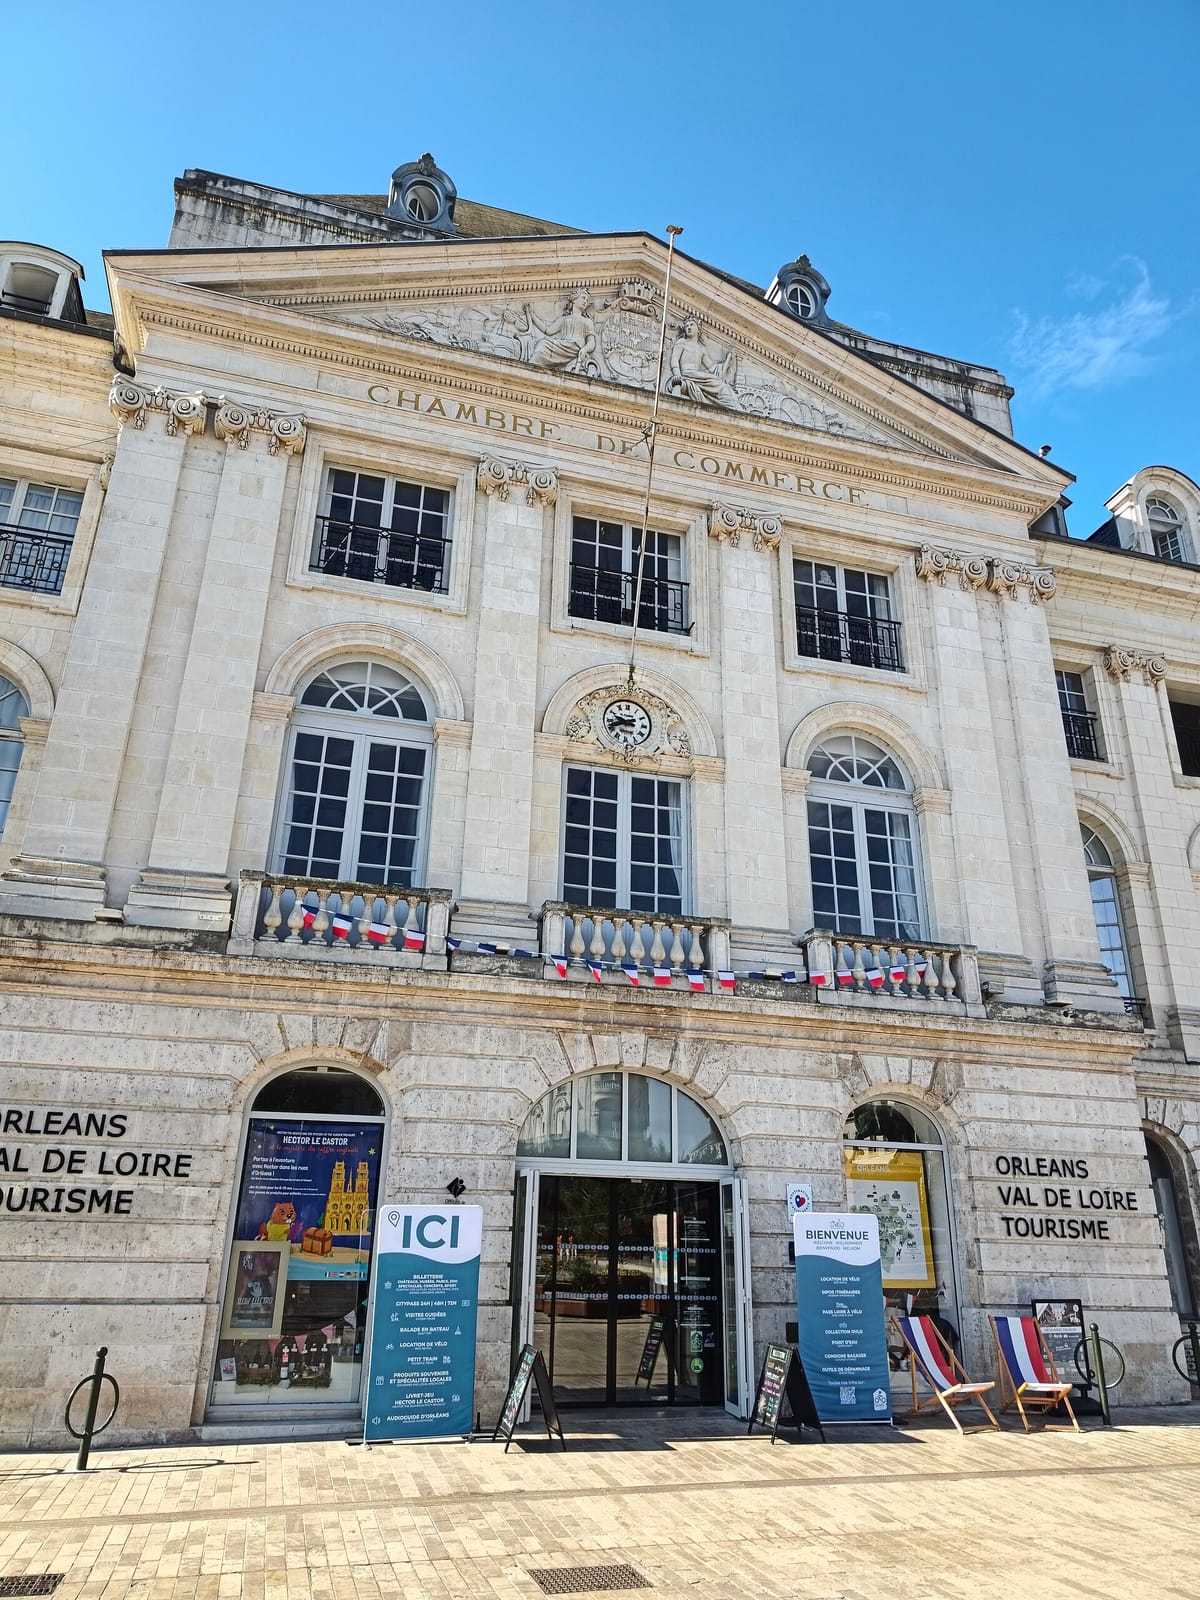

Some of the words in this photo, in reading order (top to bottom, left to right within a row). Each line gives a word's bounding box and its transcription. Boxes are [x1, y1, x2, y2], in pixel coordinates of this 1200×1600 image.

[368, 385, 561, 441] CHAMBRE
[597, 435, 638, 458] DE
[674, 451, 868, 506] COMMERCE
[0, 1110, 127, 1137] RLEANS
[283, 1136, 310, 1144] HECTOR
[312, 1137, 320, 1145] LE
[322, 1137, 348, 1145] CASTOR
[42, 1149, 87, 1174] DE
[98, 1152, 192, 1177] LOIRE
[996, 1156, 1088, 1178] ORLEANS
[0, 1187, 133, 1214] URISME
[998, 1185, 1038, 1206] VAL
[1045, 1188, 1072, 1208] DE
[1079, 1189, 1138, 1210] LOIRE
[402, 1215, 459, 1248] ICI
[806, 1230, 869, 1240] BIENVENUE
[1001, 1217, 1109, 1240] TOURISME
